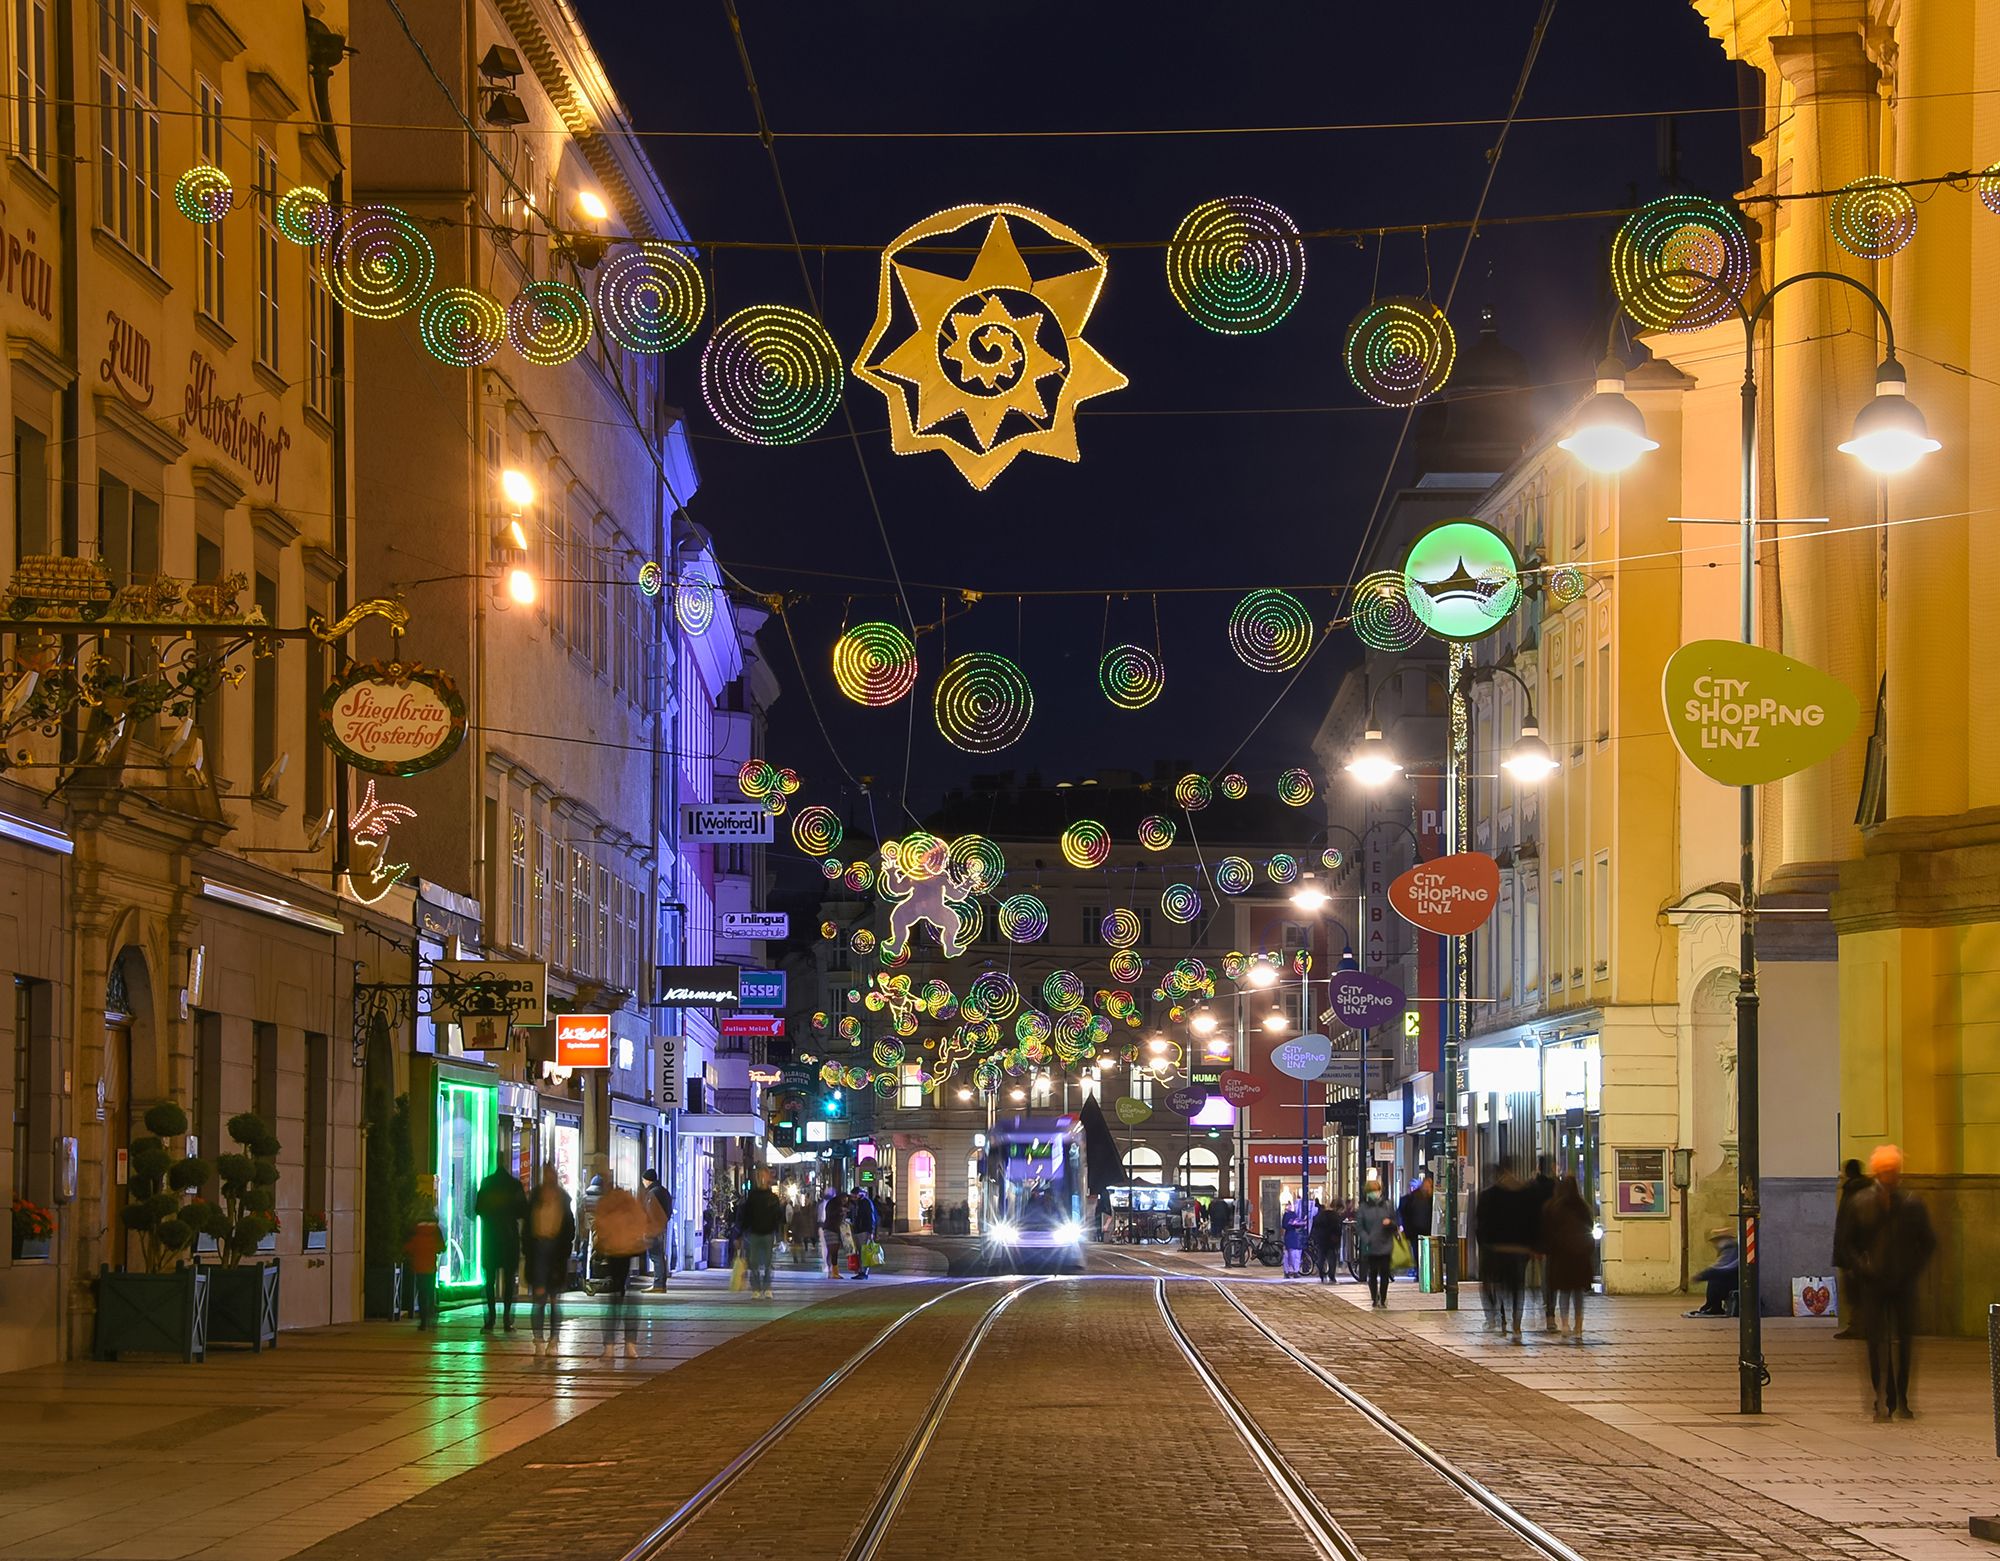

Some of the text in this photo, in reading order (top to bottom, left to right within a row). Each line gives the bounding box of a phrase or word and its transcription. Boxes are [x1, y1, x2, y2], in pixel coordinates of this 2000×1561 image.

[100, 310, 154, 411] Zum
[1693, 676, 1750, 700] CITY
[341, 687, 445, 724] Stieglbräu
[1685, 698, 1825, 726] SHOPPING
[343, 721, 449, 753] Klosterhof
[1701, 726, 1760, 749] LINZ
[702, 816, 752, 830] Wolford
[1413, 872, 1447, 889] CITY
[1409, 885, 1489, 902] SHOPPING
[1417, 900, 1453, 915] LINZ
[741, 914, 785, 926] inlingua
[741, 981, 781, 996] össer
[1340, 985, 1363, 995] CITY
[1337, 994, 1393, 1006] SHOPPING
[1343, 1005, 1368, 1015] LINZ
[724, 1025, 769, 1033] Julius Meinl
[662, 1041, 678, 1103] pimkie
